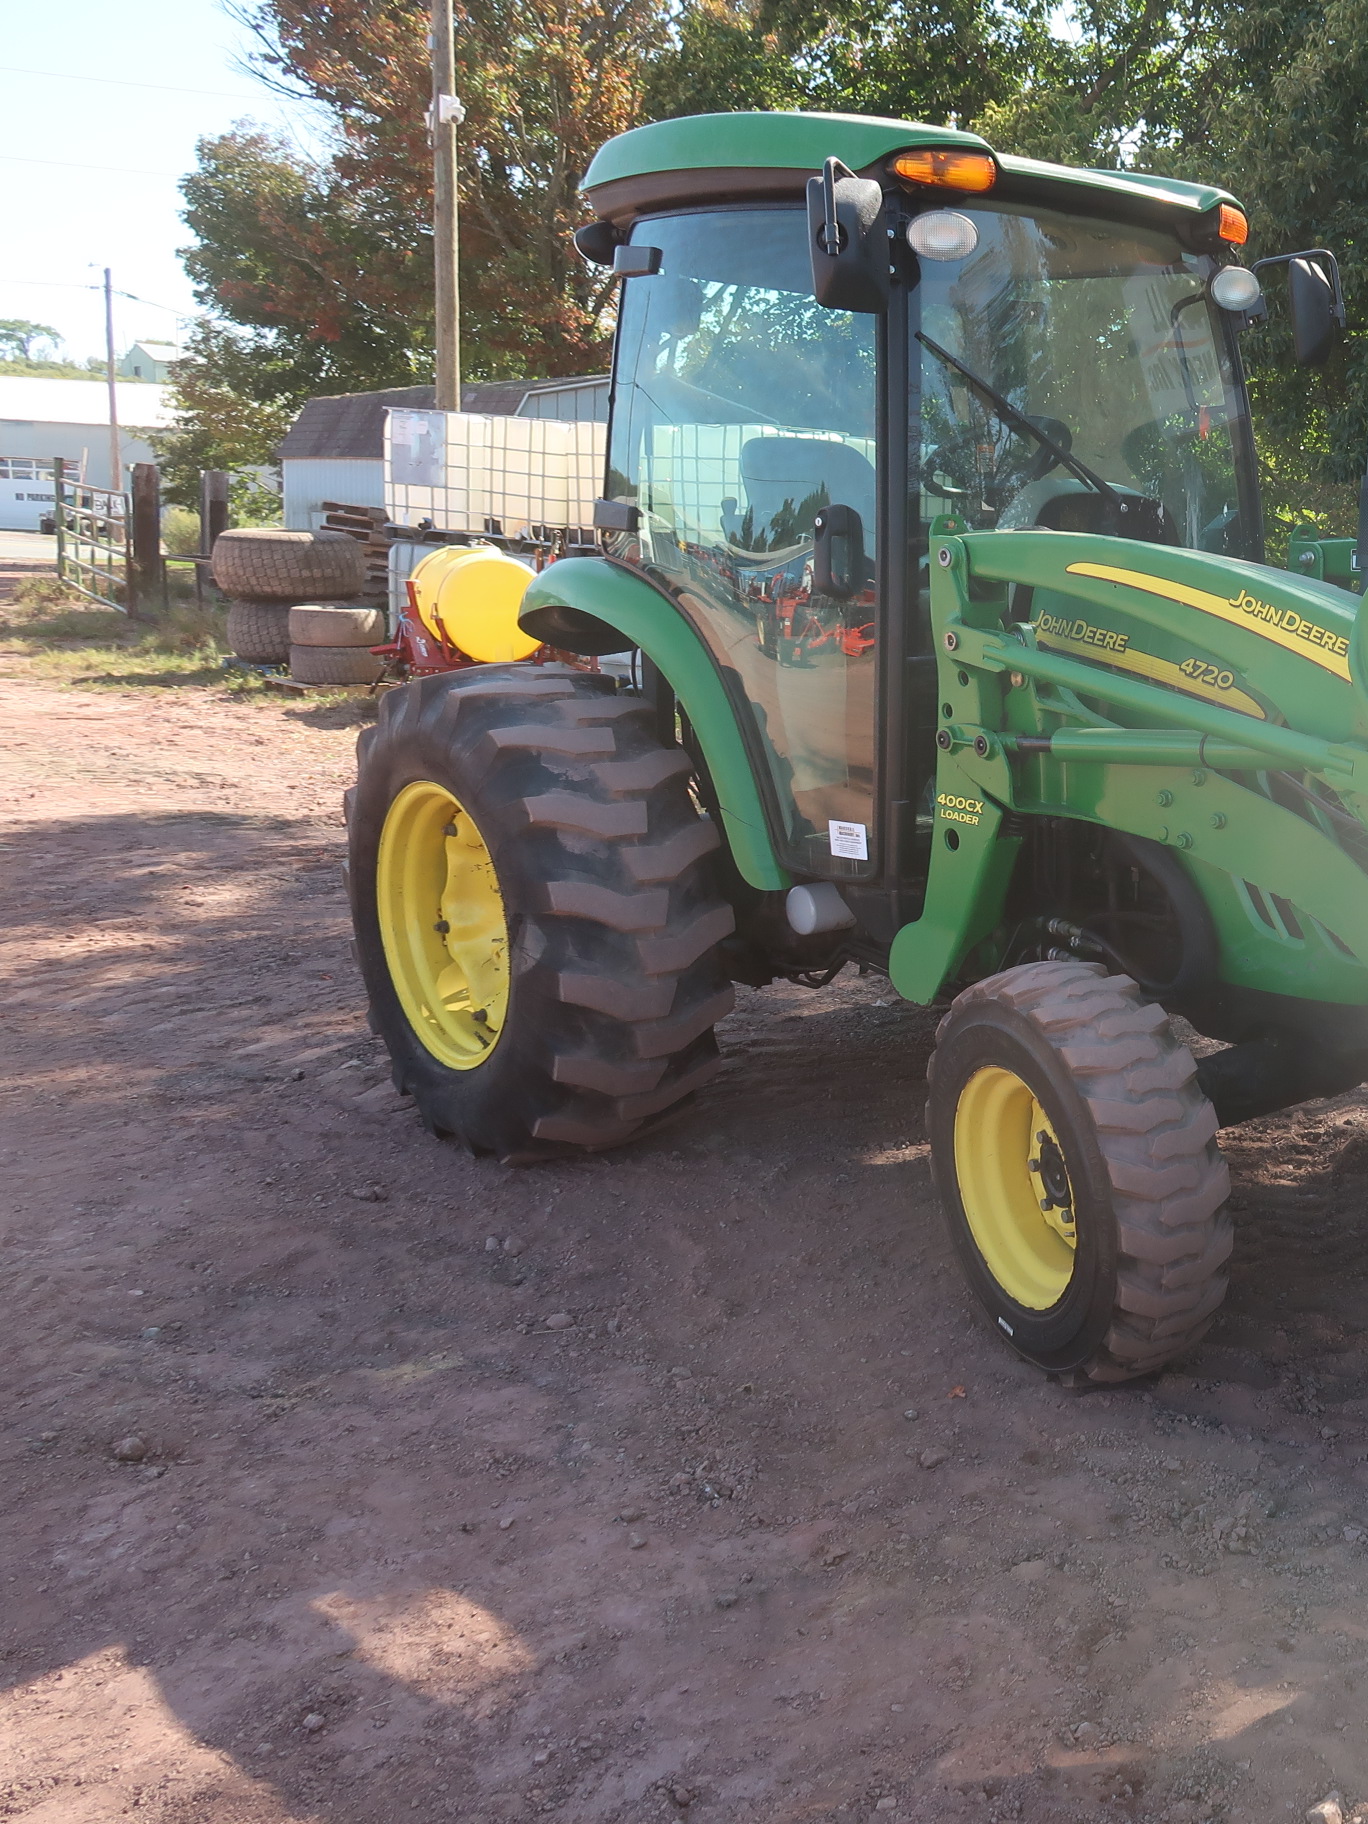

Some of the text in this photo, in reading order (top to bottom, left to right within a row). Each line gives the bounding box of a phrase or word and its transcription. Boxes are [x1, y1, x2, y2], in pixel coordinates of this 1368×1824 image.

[1028, 609, 1130, 653] JOHN DEERE
[1229, 590, 1350, 657] JOHN DEERE
[1179, 657, 1235, 689] 4720
[937, 793, 984, 815] 400CX
[940, 808, 980, 826] LOADER
